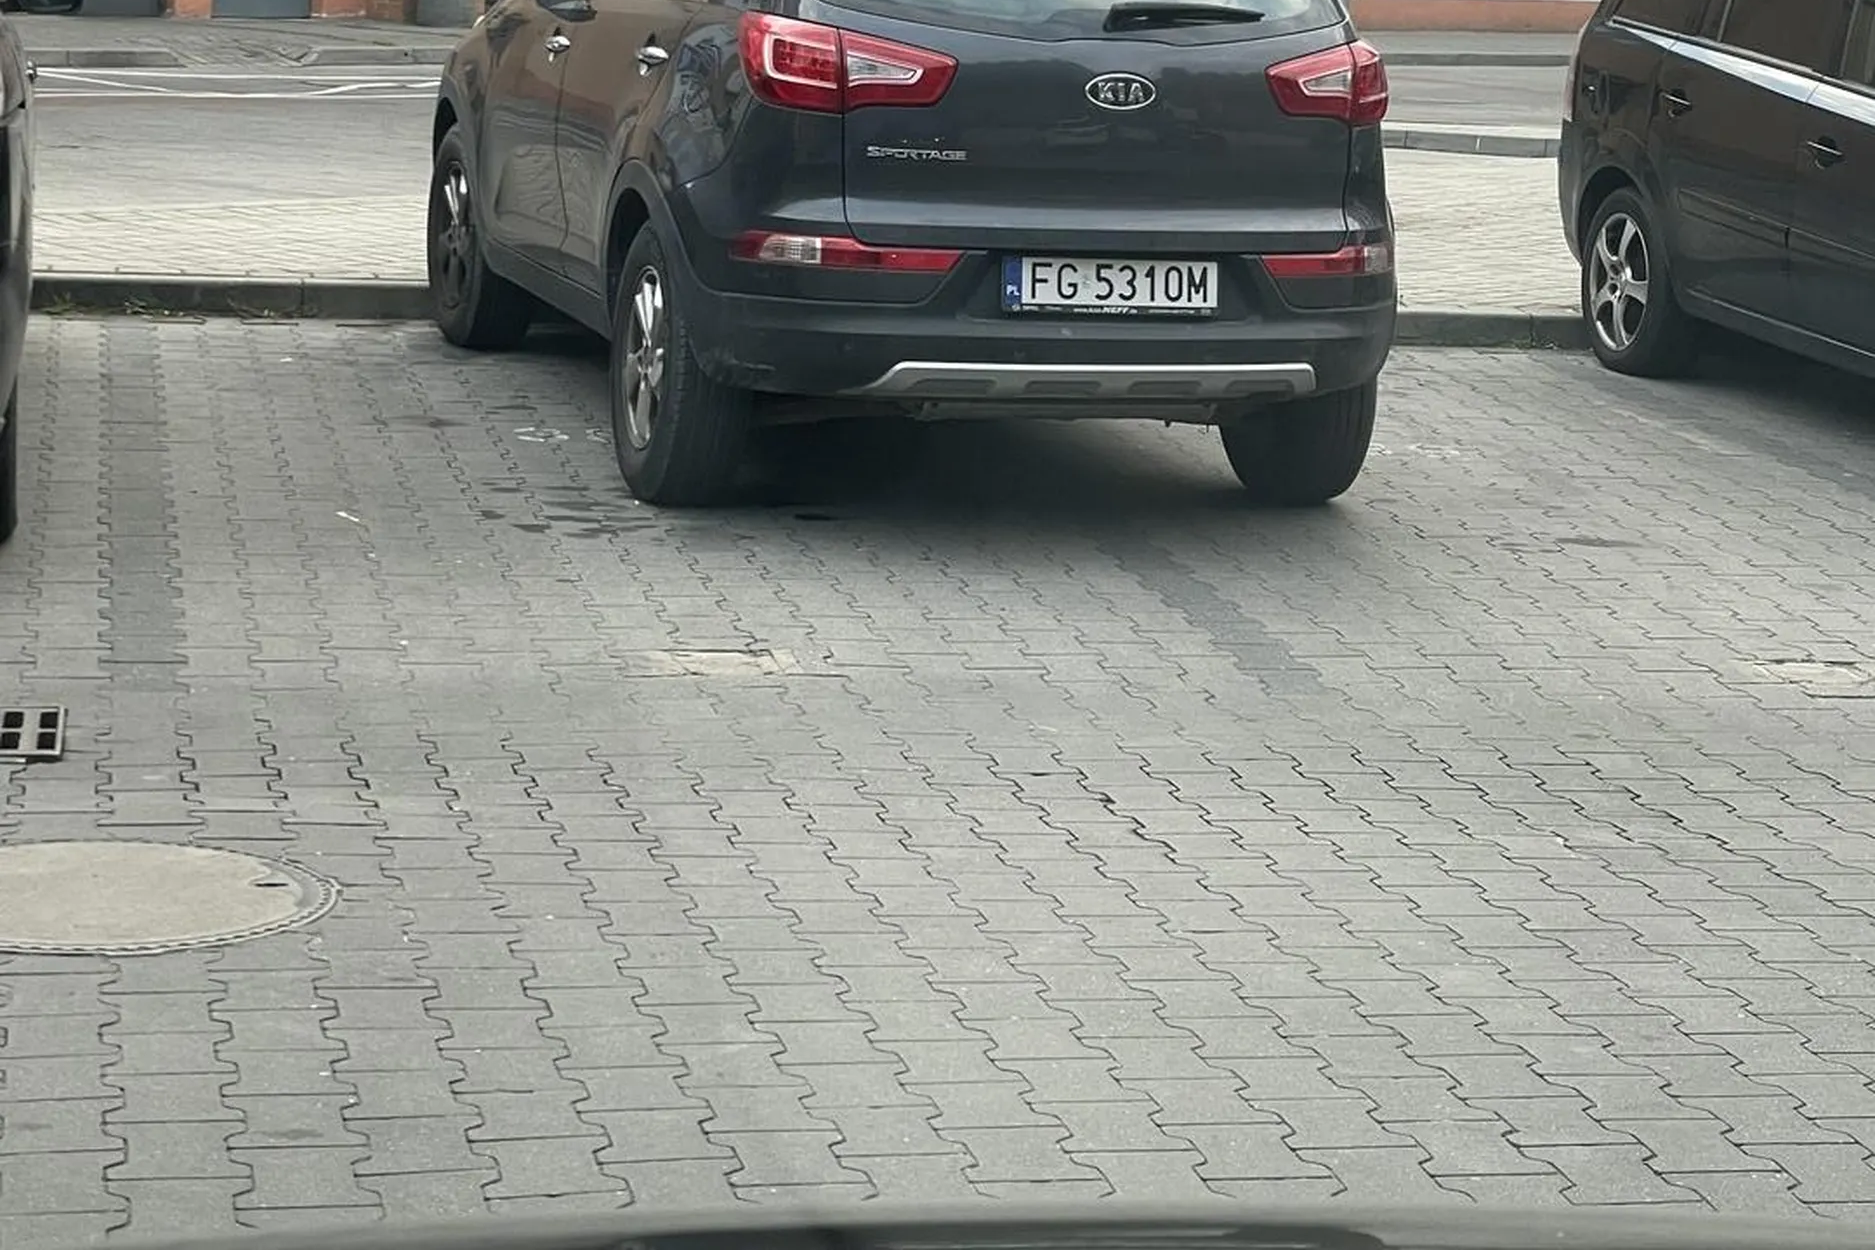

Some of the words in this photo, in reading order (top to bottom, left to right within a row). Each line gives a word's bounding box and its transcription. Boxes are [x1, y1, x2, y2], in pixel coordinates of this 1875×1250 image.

[1098, 82, 1145, 102] KIA
[866, 146, 967, 160] SPORTAGE
[1006, 284, 1020, 296] PL
[1031, 262, 1078, 300] FG
[1095, 263, 1208, 303] 5310M
